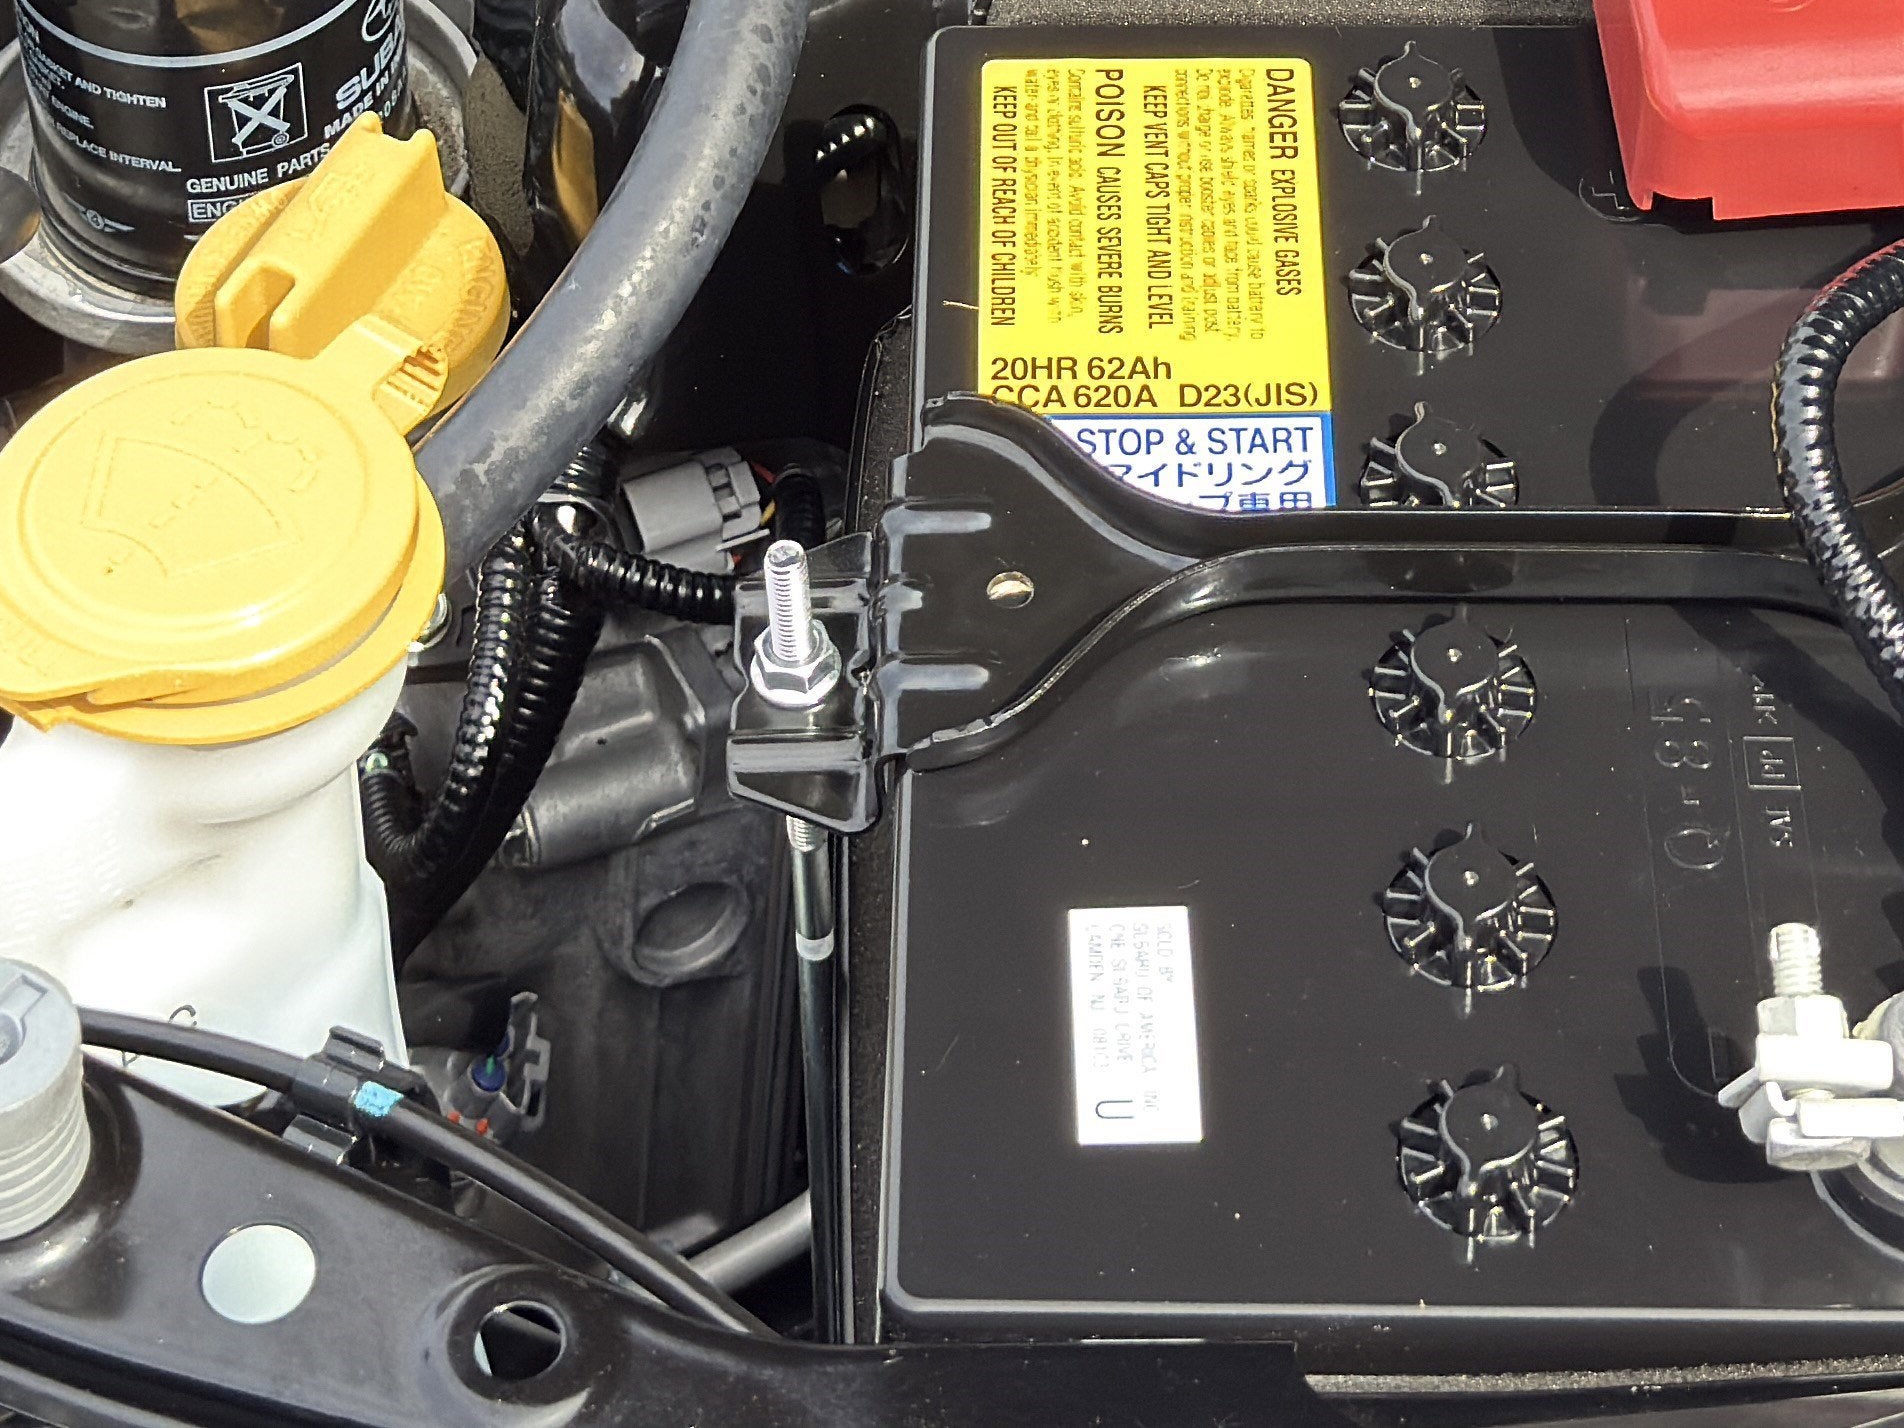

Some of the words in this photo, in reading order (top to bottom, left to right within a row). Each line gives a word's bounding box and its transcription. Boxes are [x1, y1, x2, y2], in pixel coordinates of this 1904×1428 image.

[74, 77, 101, 95] AND
[105, 86, 166, 109] TIGHTEN
[993, 86, 1017, 119] KEEP
[1144, 85, 1168, 119] KEEP
[324, 104, 375, 138] MADE
[1024, 102, 1040, 120] and
[1095, 69, 1126, 157] POISON
[1266, 68, 1298, 160] DANGER
[992, 124, 1017, 150] OUT
[1144, 123, 1169, 157] VENT
[186, 169, 270, 195] GENUINE
[277, 144, 332, 177] PARTS
[992, 156, 1017, 174] OF
[1144, 162, 1170, 198] CAPS
[991, 179, 1016, 224] REACH
[1068, 185, 1086, 216] Avoid
[1097, 166, 1122, 220] CAUSES
[1200, 177, 1216, 217] booster
[1271, 169, 1298, 244] EXPLOSIVE
[991, 230, 1016, 248] OF
[1068, 219, 1086, 258] contact
[1146, 203, 1172, 245] TIGHT
[1224, 218, 1239, 237] and
[1097, 227, 1122, 278] SEVERE
[1146, 250, 1172, 279] AND
[990, 253, 1016, 326] CHILDREN
[1069, 262, 1086, 287] with
[1275, 250, 1302, 296] GASES
[1098, 285, 1124, 334] BURNS
[1148, 285, 1173, 329] LEVEL
[1246, 282, 1265, 324] battery
[1250, 328, 1265, 339] to
[991, 356, 1077, 381] 20HR
[1087, 356, 1172, 380] 62Ah
[1073, 384, 1157, 408] 620A
[1178, 382, 1318, 409] D23(JIS)
[1076, 428, 1164, 456] STOP
[1175, 427, 1197, 456] &
[1206, 427, 1314, 454] START
[1136, 986, 1153, 1004] OF
[1094, 1099, 1134, 1121] U
